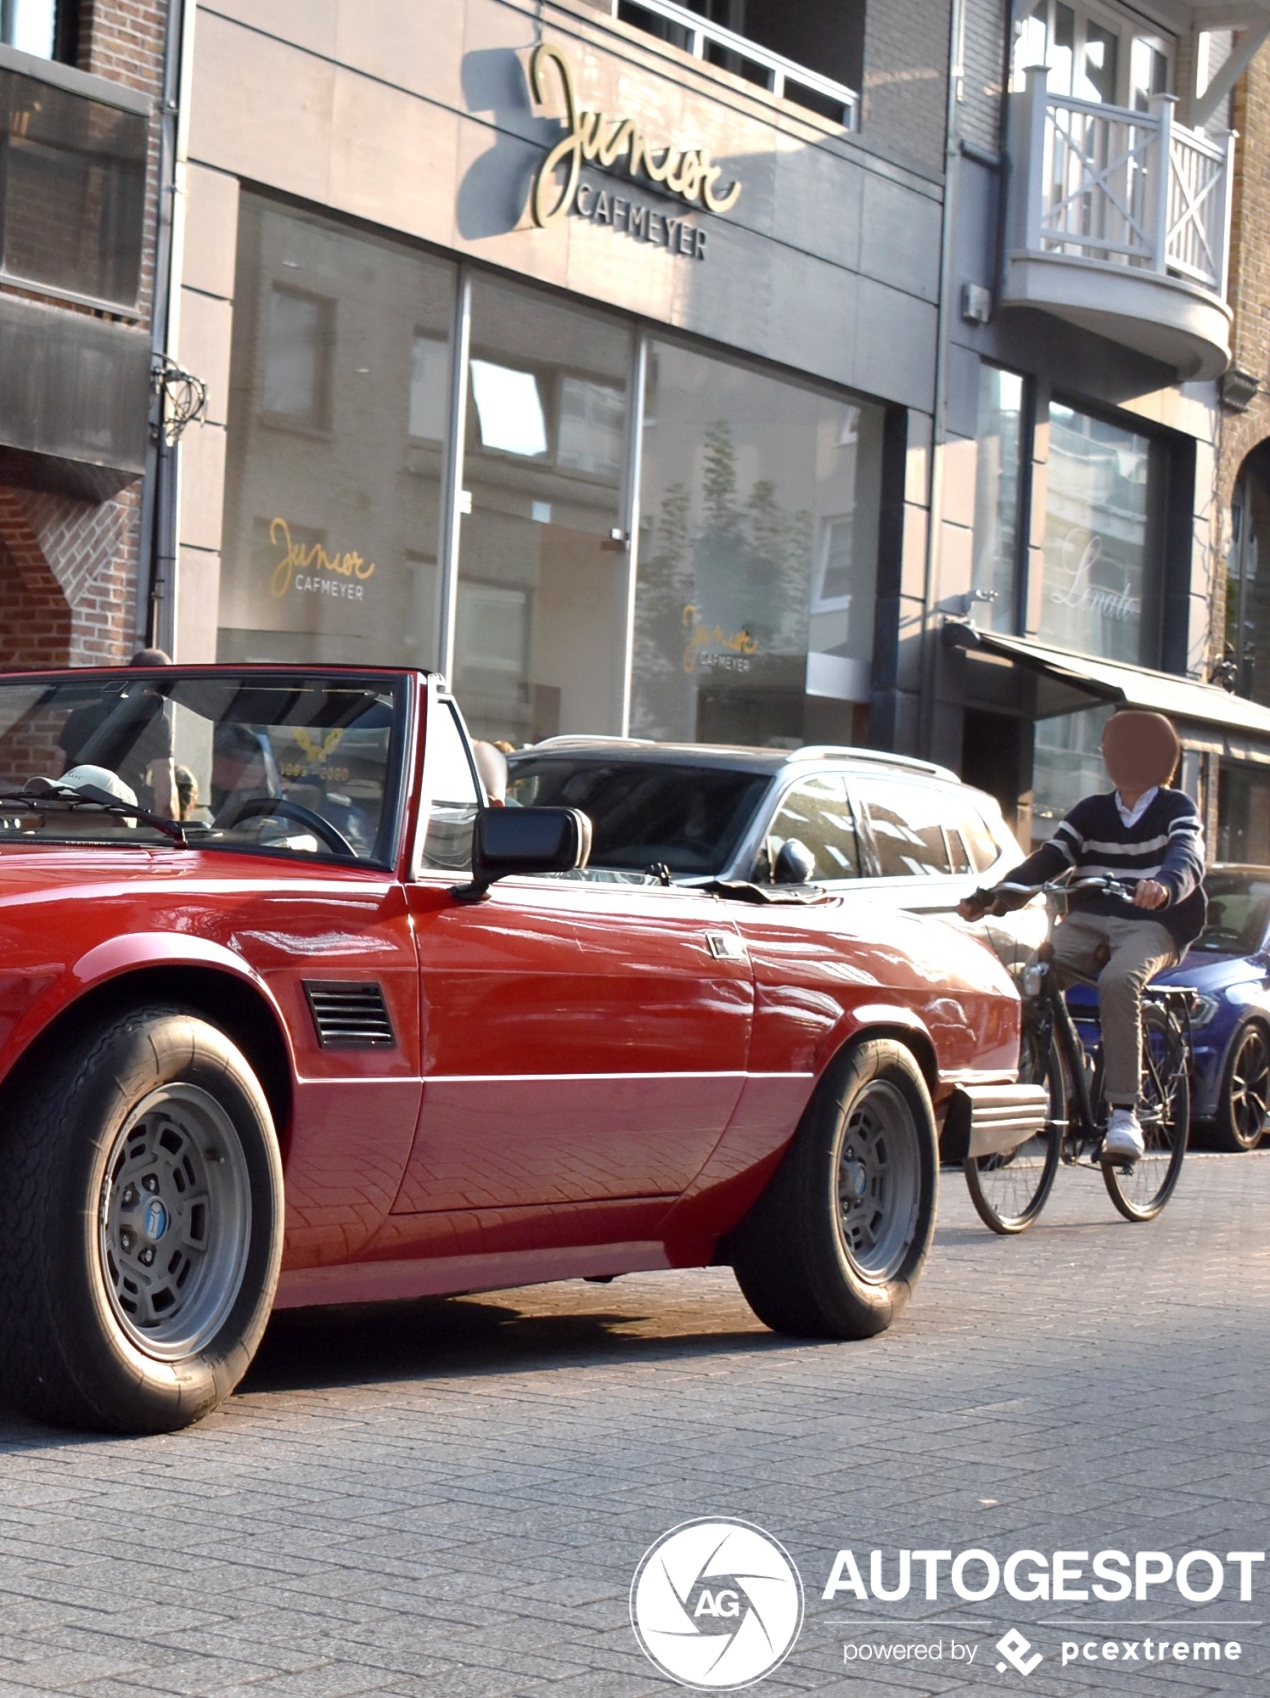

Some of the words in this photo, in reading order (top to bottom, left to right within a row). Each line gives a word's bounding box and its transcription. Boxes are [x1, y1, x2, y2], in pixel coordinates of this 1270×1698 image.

[530, 44, 742, 229] Junior
[575, 182, 707, 261] CAFMEYER
[270, 516, 376, 598] Junior
[294, 573, 365, 601] CAFMEYER
[699, 650, 750, 674] CAFMEYER
